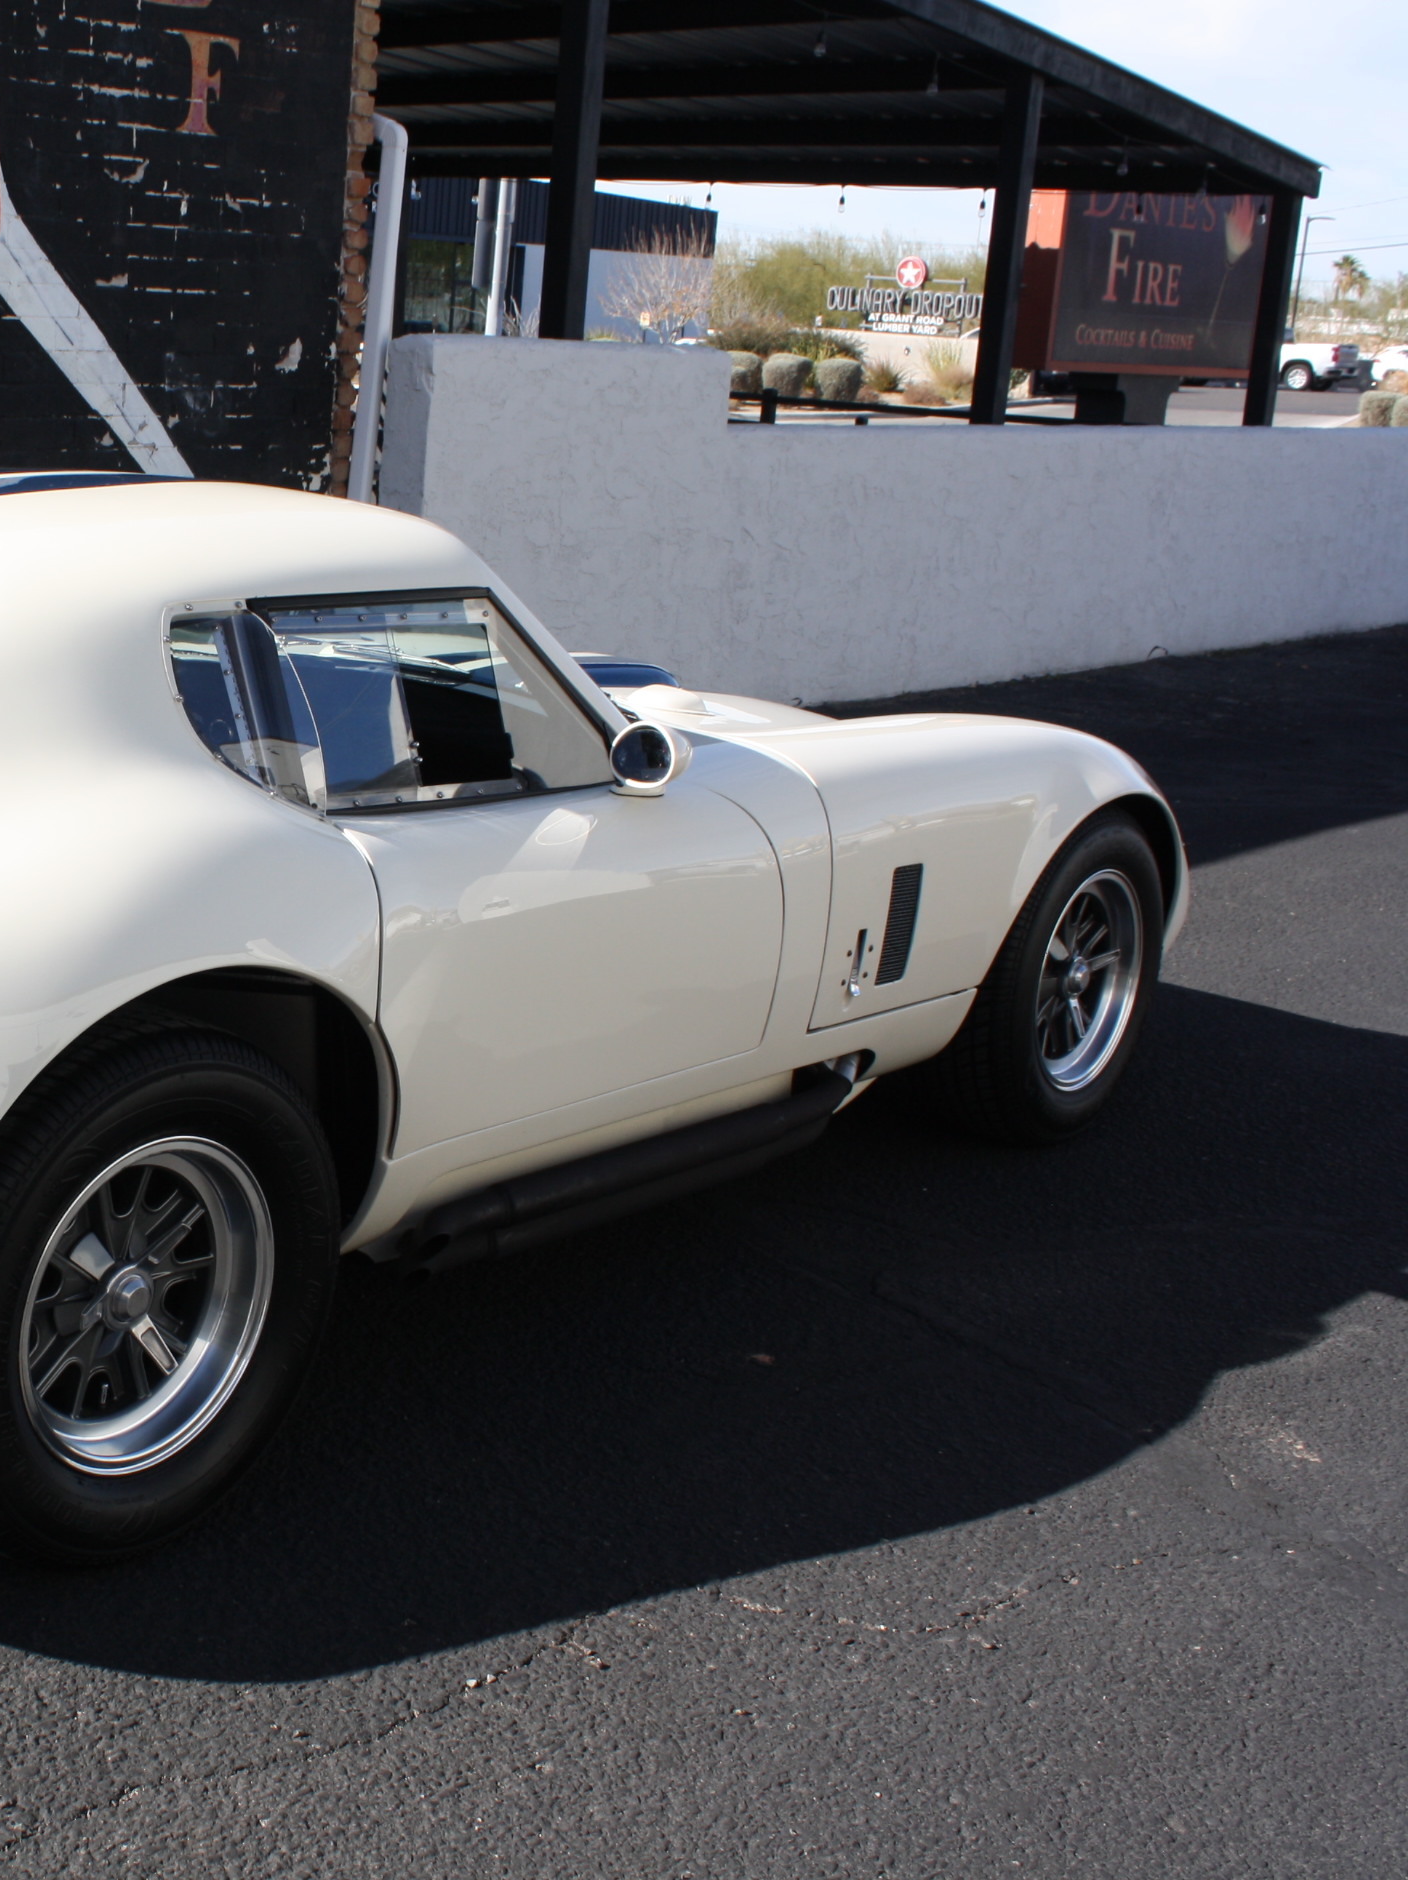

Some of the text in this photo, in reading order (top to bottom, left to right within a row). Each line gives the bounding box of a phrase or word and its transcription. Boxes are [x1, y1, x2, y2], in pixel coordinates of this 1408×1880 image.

[1101, 227, 1183, 306] FIRE
[827, 286, 983, 319] CULINARY DROPOUT
[868, 312, 944, 326] AT GRANT ROAD
[873, 322, 937, 335] LUMBER YARD
[1075, 323, 1137, 347] COCKTAILS
[1150, 328, 1197, 350] CUISINE
